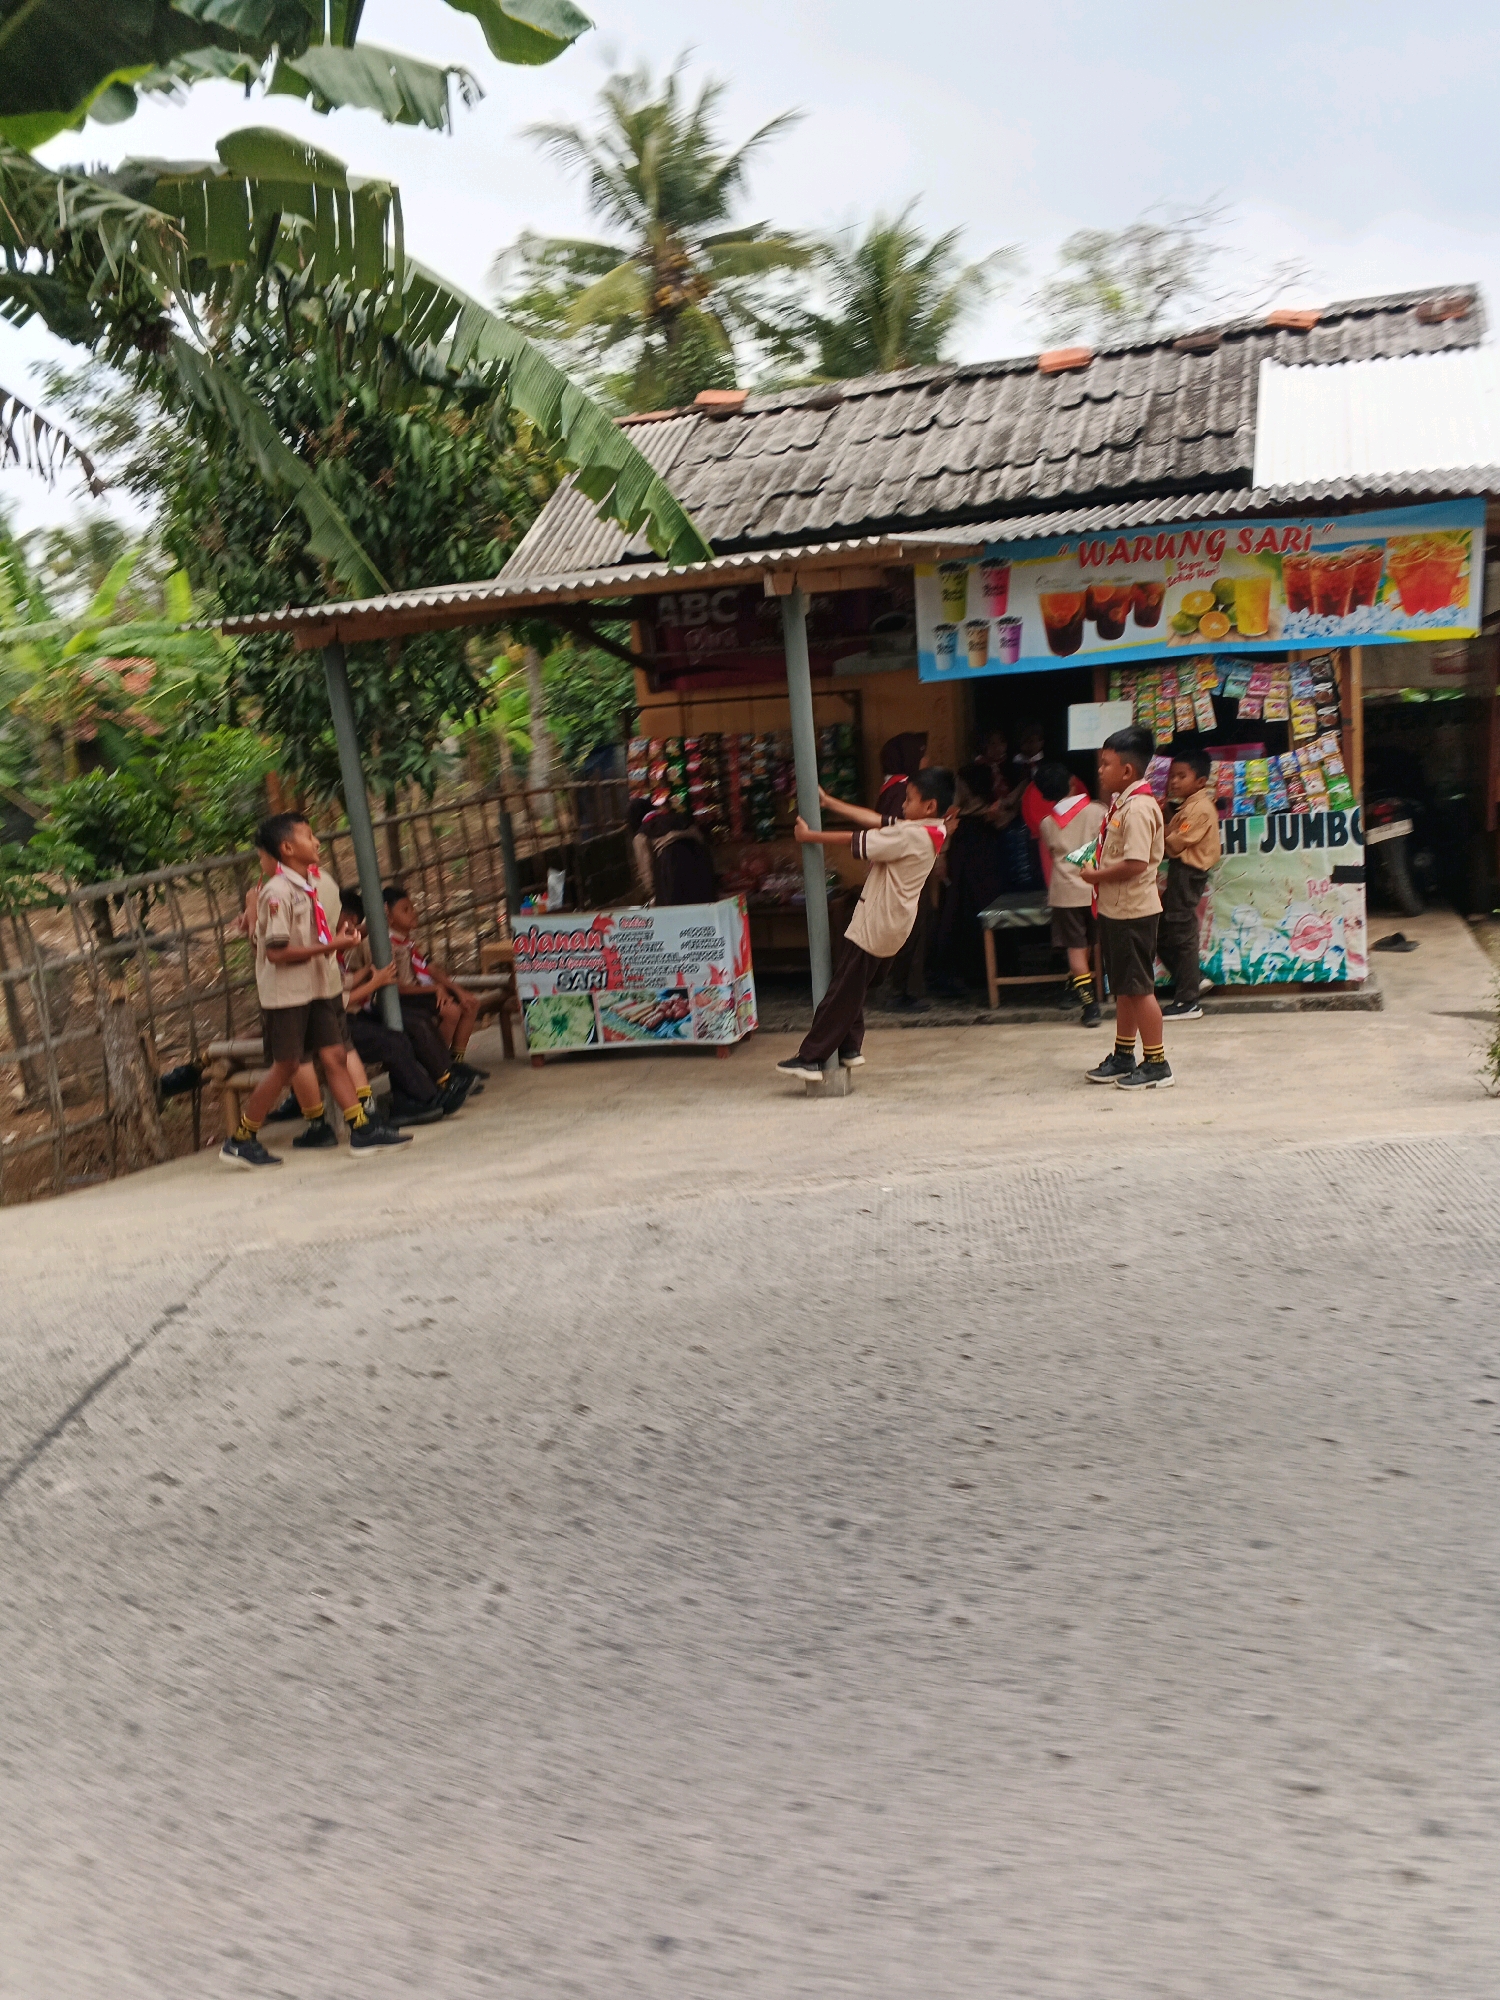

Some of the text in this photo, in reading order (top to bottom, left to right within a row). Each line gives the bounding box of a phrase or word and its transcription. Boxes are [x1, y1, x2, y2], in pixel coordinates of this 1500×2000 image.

[656, 588, 741, 629] ABC
[511, 924, 604, 960] ajanan
[557, 967, 608, 992] SARI
